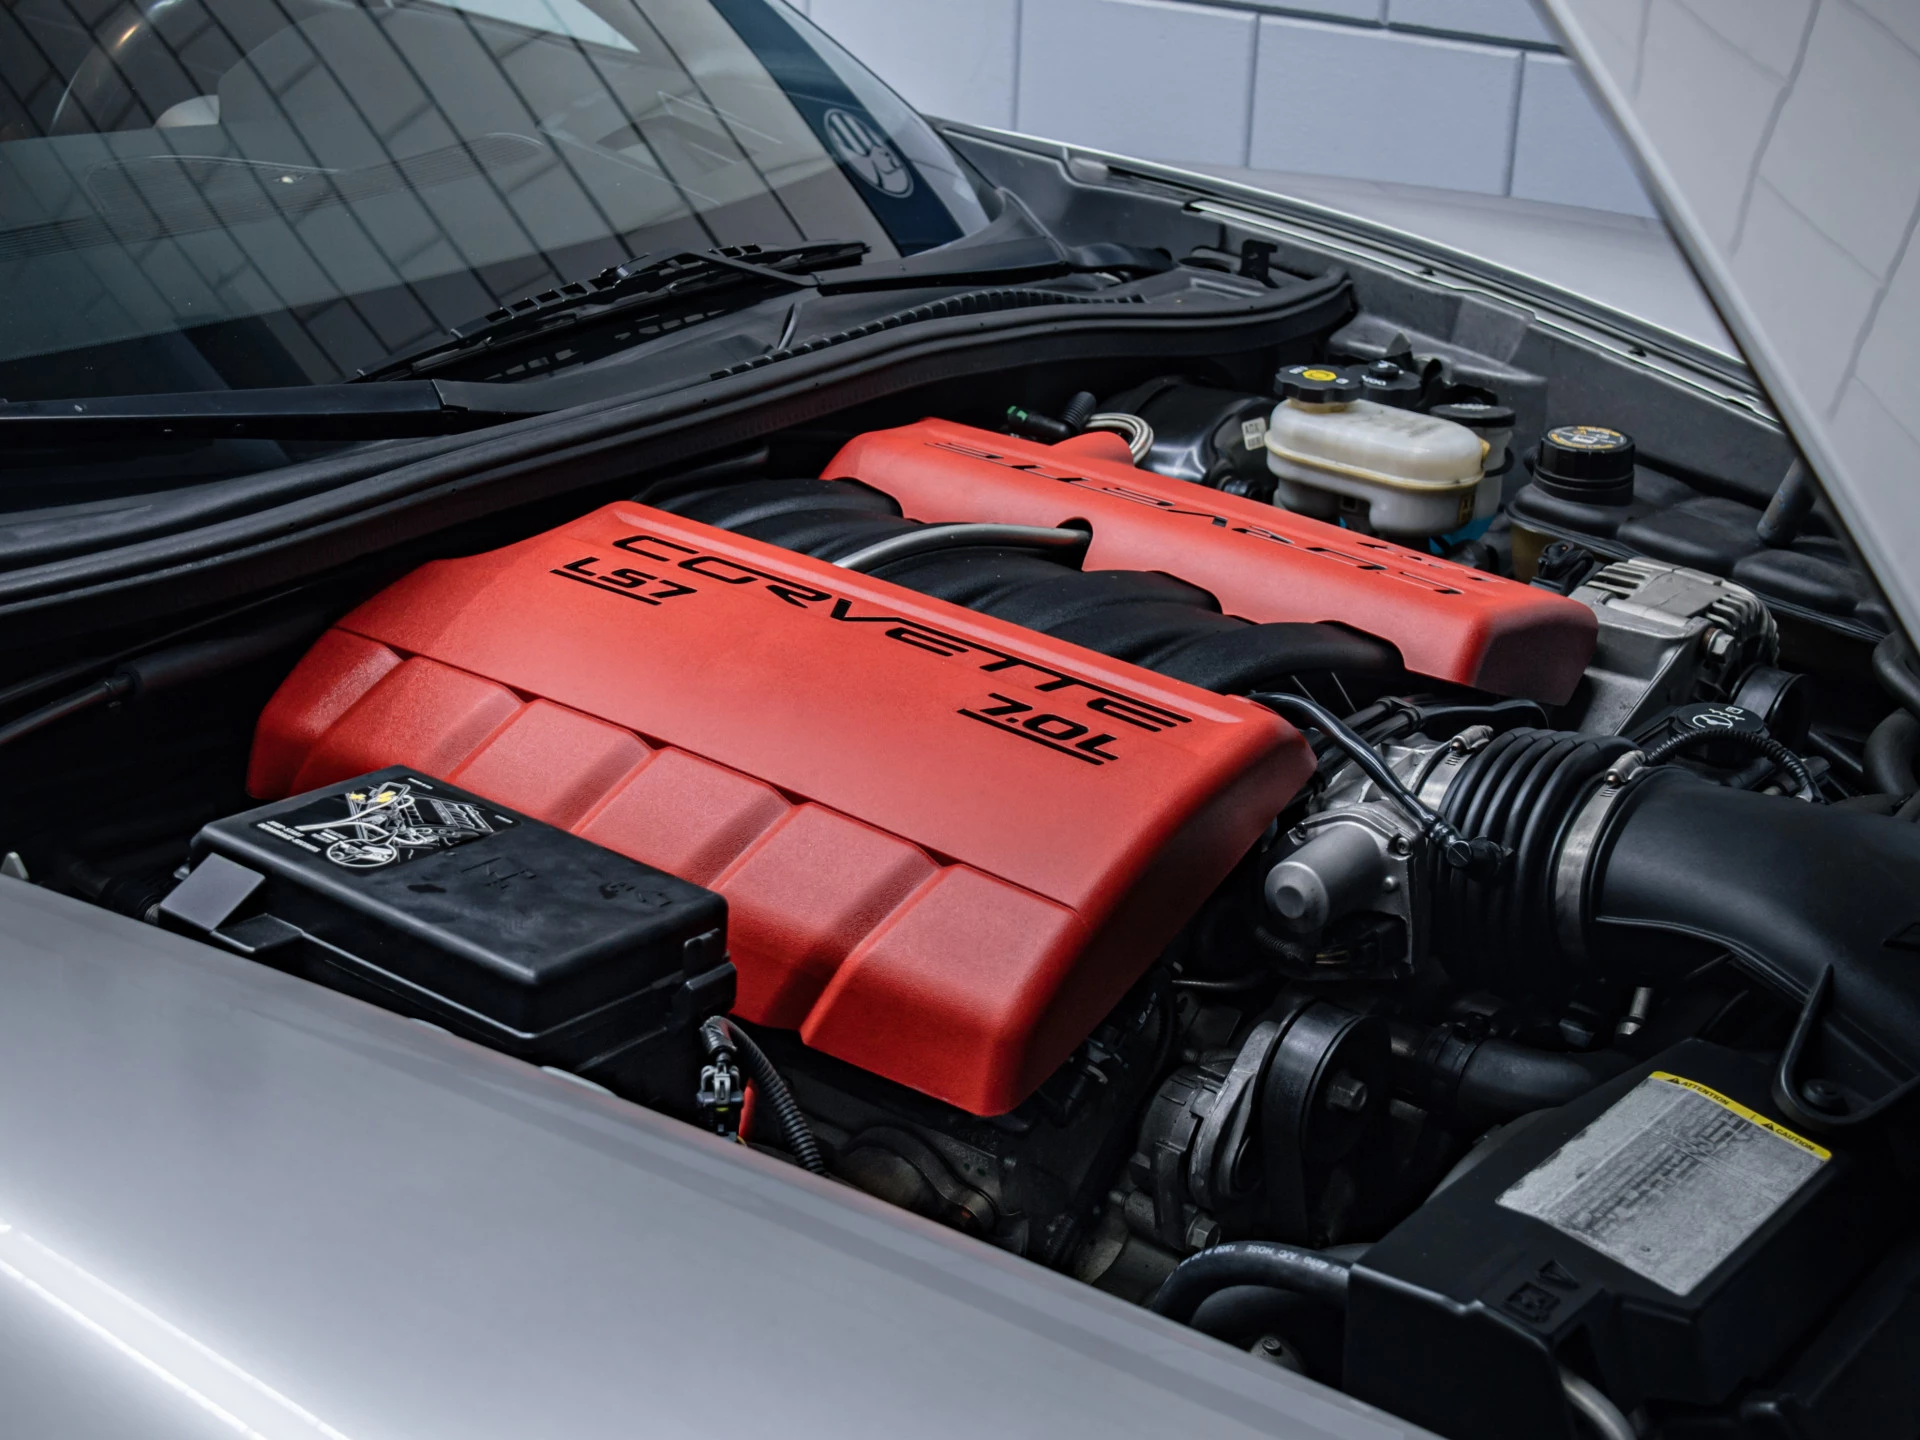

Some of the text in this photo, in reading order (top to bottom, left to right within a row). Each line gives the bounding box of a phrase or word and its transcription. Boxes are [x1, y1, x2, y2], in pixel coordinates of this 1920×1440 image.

[562, 556, 698, 599] LS7
[611, 535, 1193, 733] CORVETTE
[979, 692, 1120, 762] 7.0L
[1681, 1081, 1730, 1106] ATTENTION
[1775, 1128, 1816, 1151] CAUTION
[1245, 1244, 1275, 1255] HOSE
